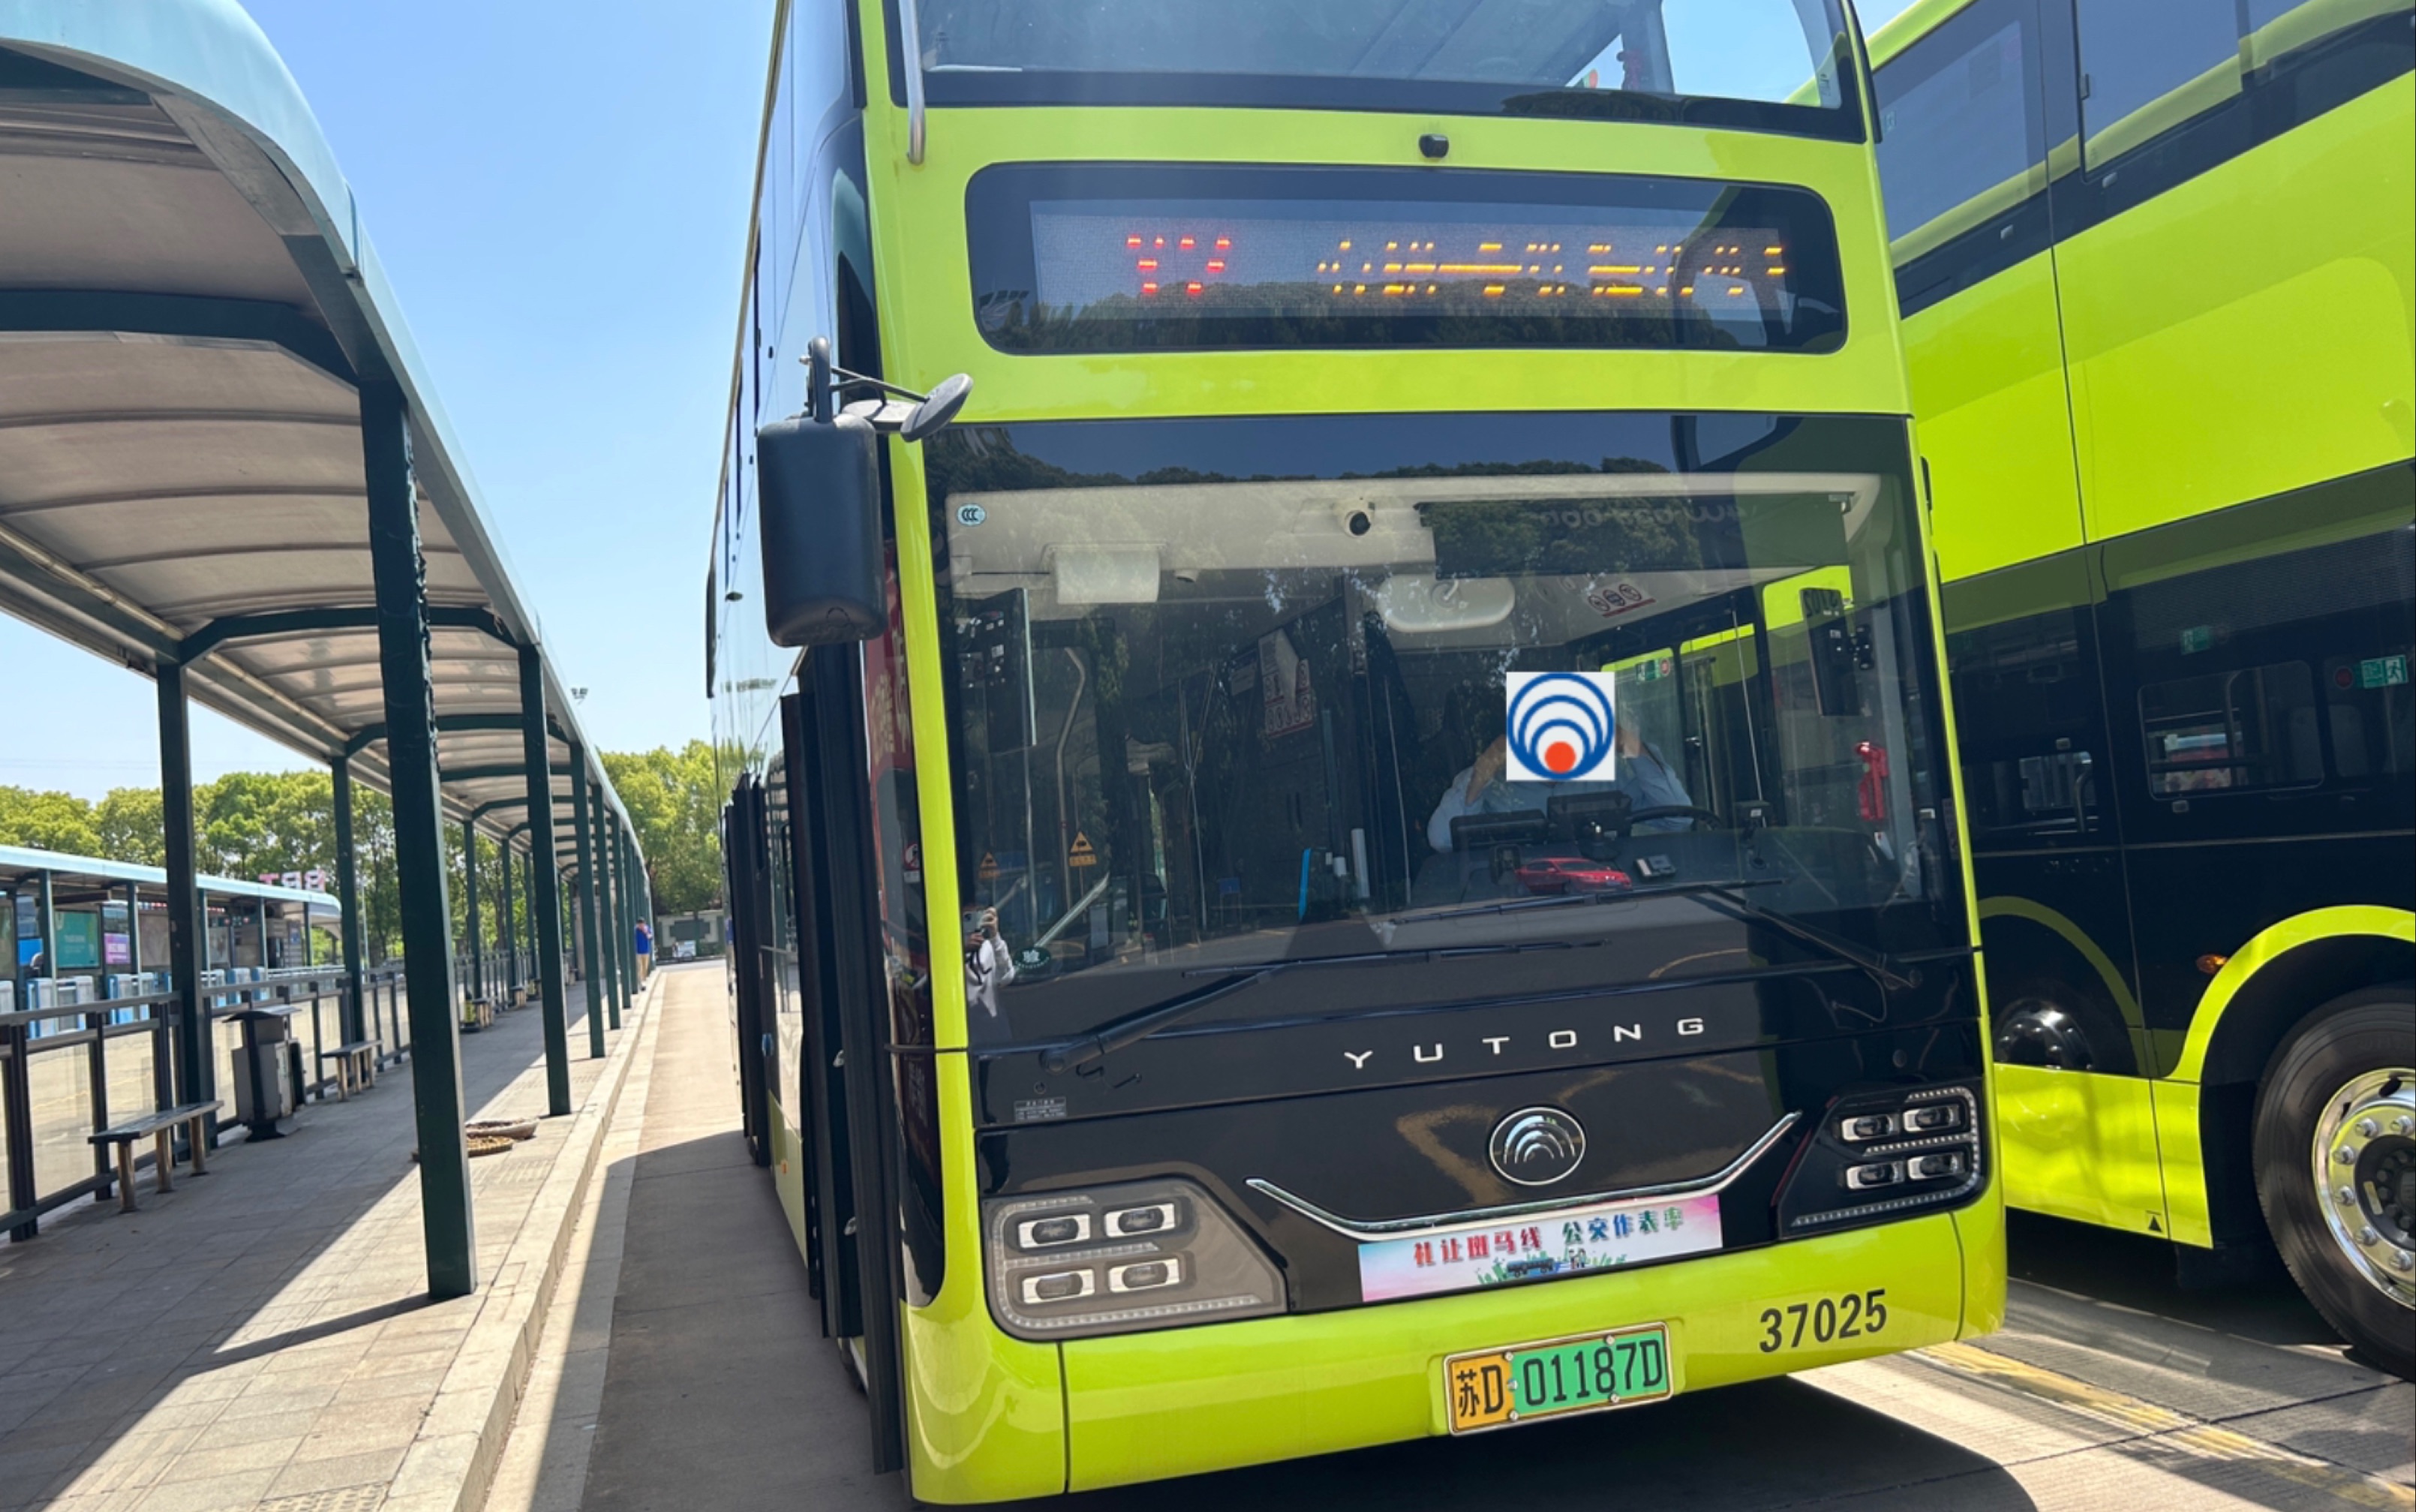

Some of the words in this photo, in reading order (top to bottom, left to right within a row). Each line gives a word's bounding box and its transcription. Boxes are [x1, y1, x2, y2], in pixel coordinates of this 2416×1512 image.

[1344, 1018, 1704, 1069] YUTONG
[1563, 1207, 1683, 1243] 公交作表率
[1759, 1288, 1887, 1353] 37025
